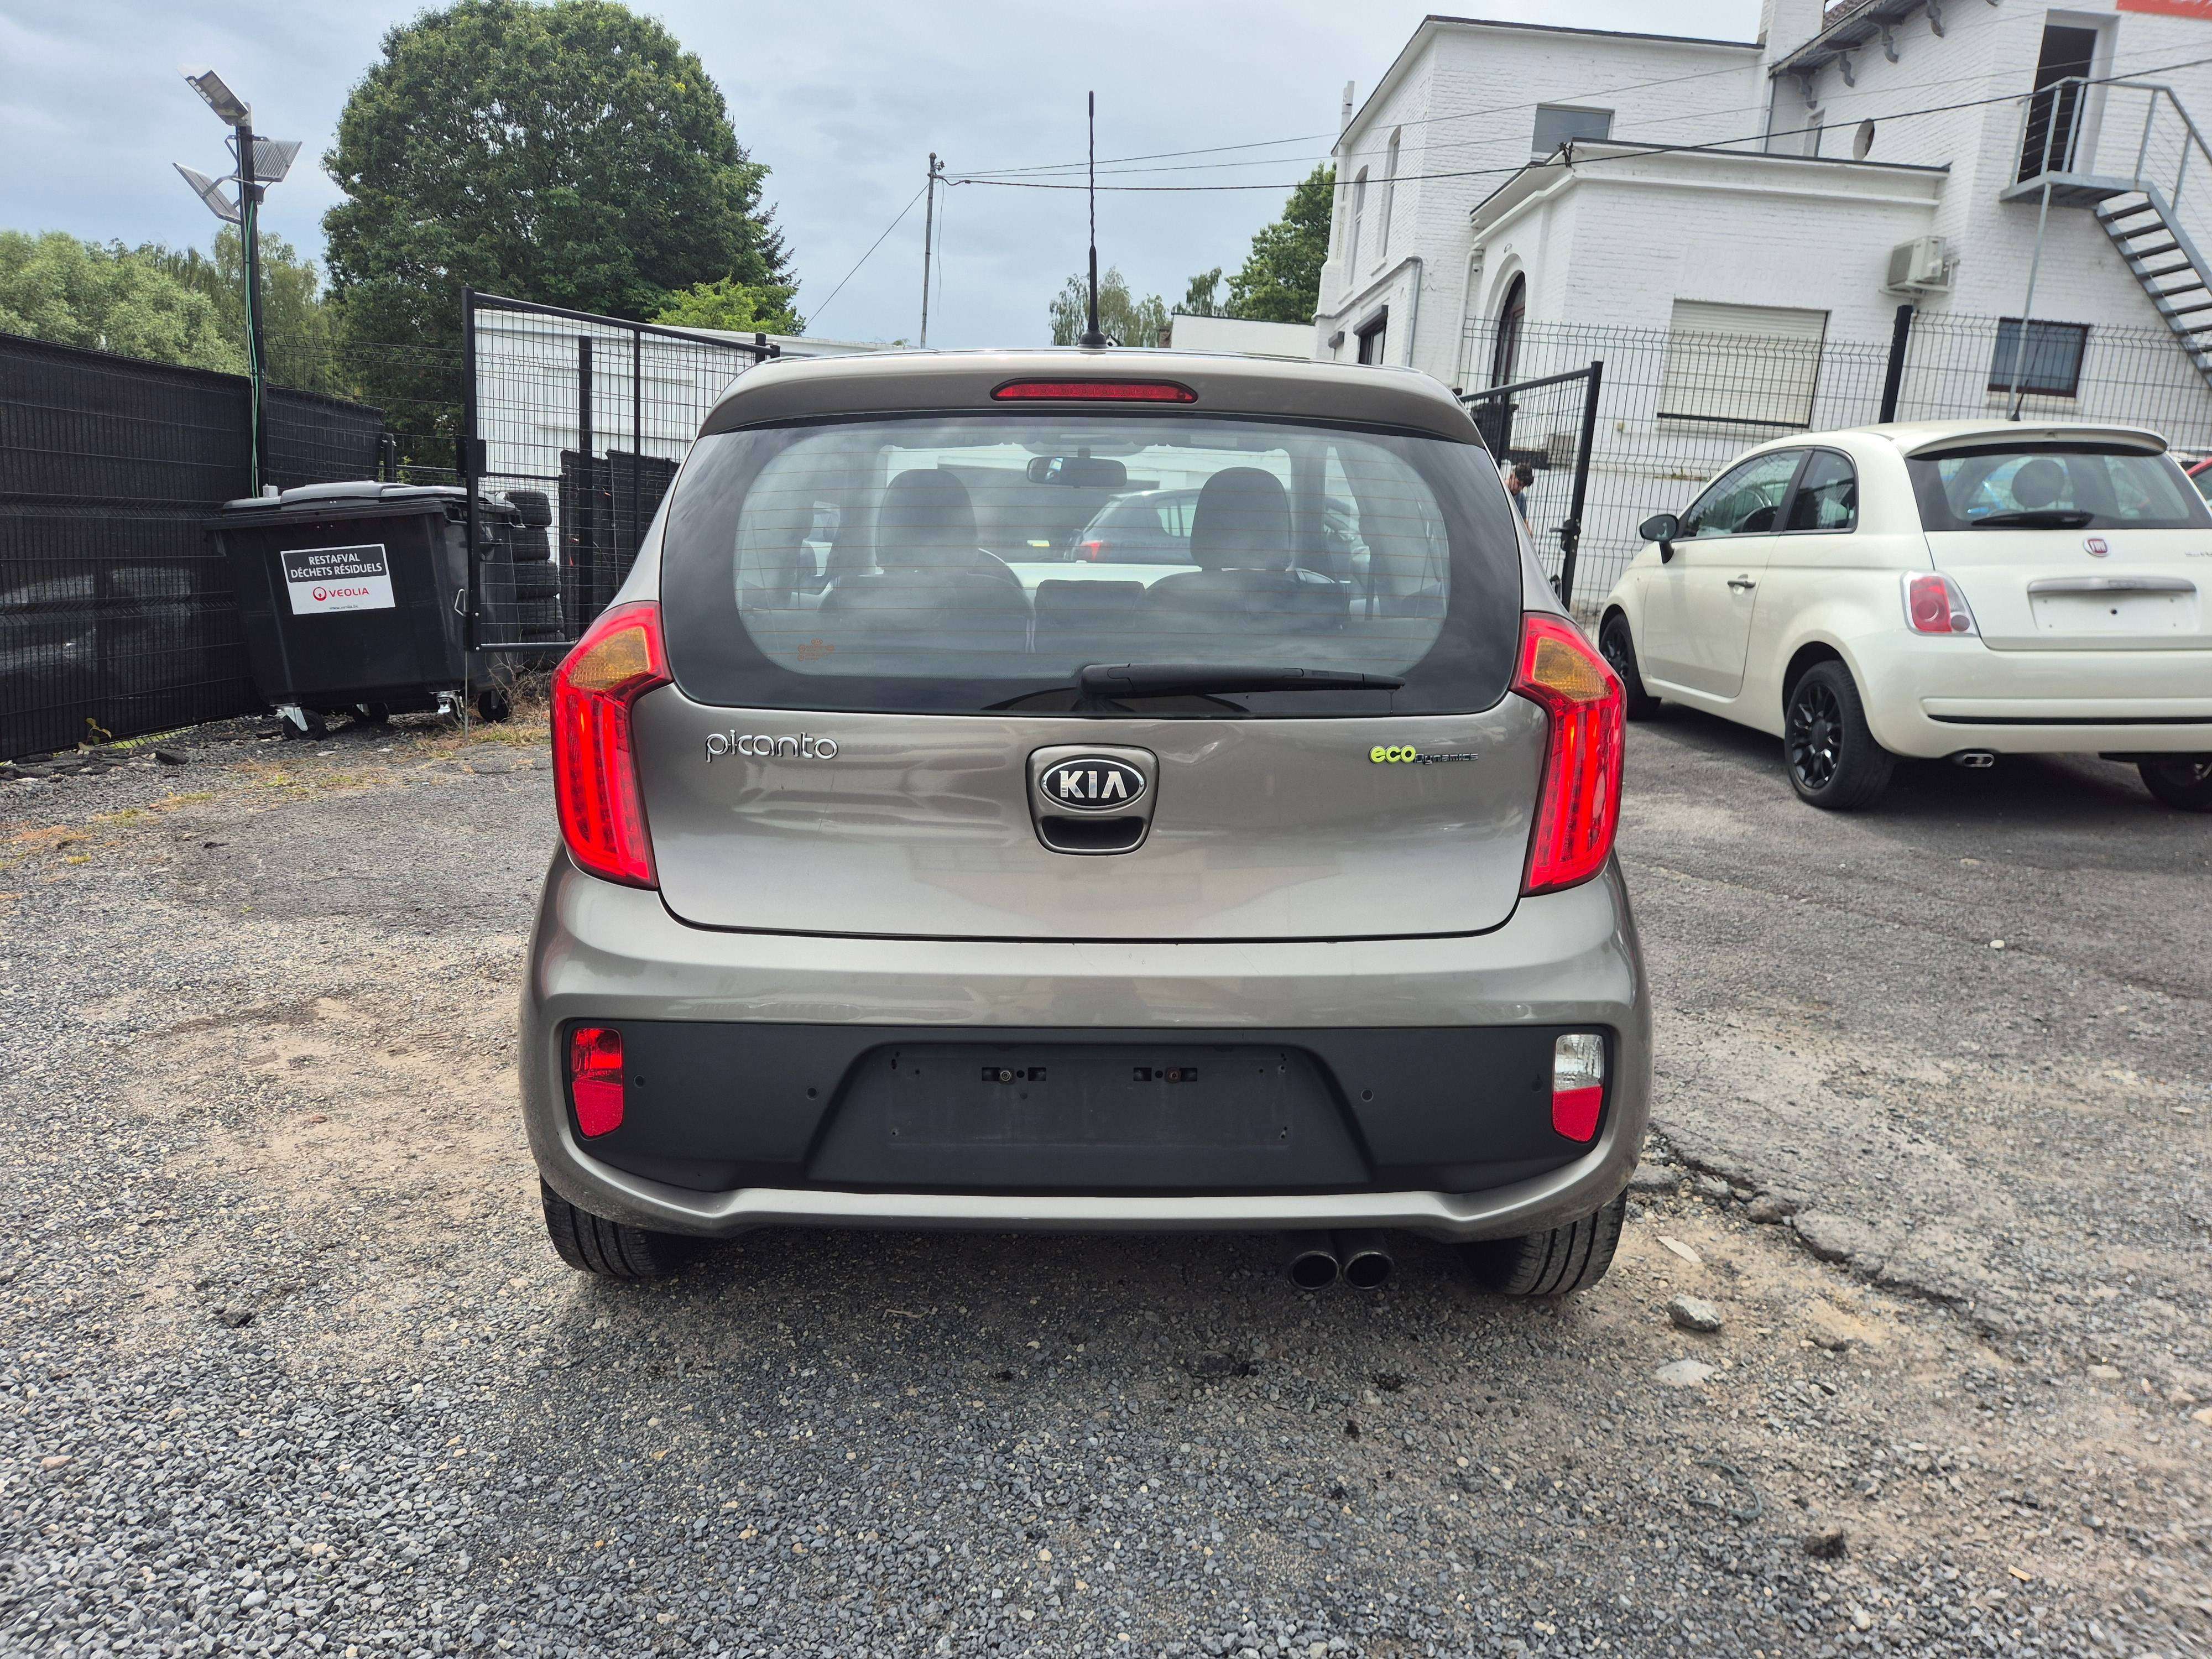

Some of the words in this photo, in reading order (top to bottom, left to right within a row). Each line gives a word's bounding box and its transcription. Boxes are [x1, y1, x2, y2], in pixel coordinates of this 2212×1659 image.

[308, 553, 361, 565] RESTAFVAL
[290, 567, 332, 578] DÉCHETS
[334, 562, 382, 575] RÉSIDUELS
[328, 587, 369, 597] VEOLIA
[705, 729, 838, 763] picanto
[1059, 770, 1128, 798] KIA
